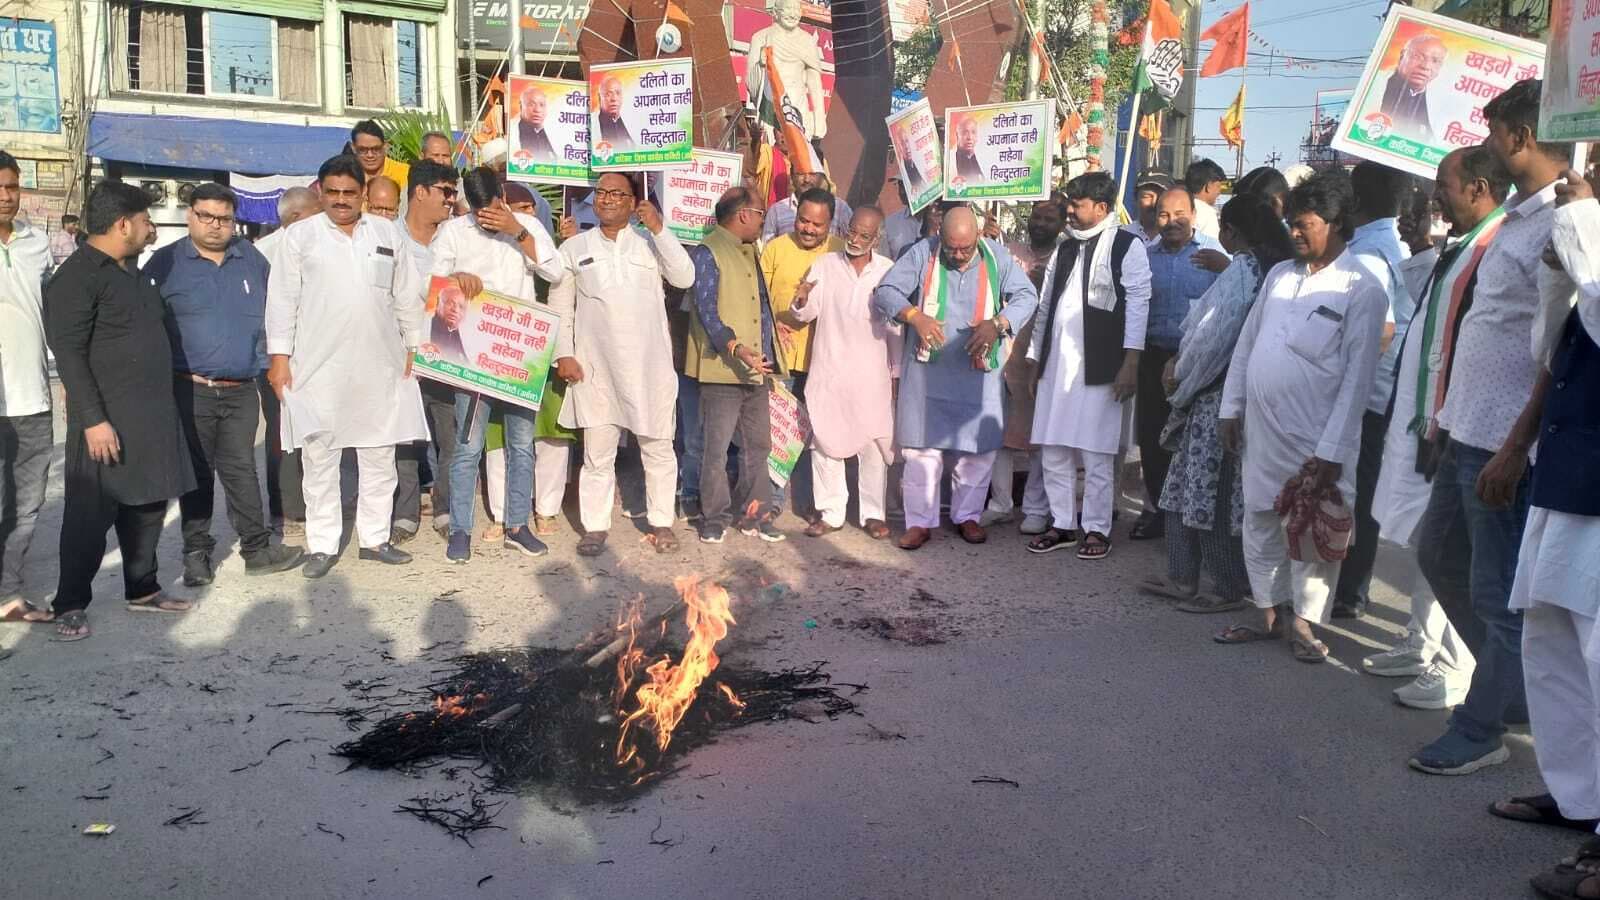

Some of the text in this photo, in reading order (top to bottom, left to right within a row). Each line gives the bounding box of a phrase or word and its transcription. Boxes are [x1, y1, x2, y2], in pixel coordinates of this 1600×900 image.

[671, 73, 685, 86] का
[633, 93, 671, 108] अपमान
[558, 112, 591, 125] अपमा
[649, 109, 677, 125] सहेगा
[1020, 114, 1033, 126] का
[574, 128, 591, 143] सहे
[640, 128, 687, 148] हिन्दुस्तान
[986, 132, 1019, 146] अपमान
[999, 147, 1024, 162] सहेगा
[717, 166, 732, 178] का
[990, 164, 1031, 183] हिन्दुस्तान
[670, 176, 708, 192] अपमान
[682, 193, 712, 209] सहेगा
[516, 312, 532, 328] जी
[534, 318, 551, 334] का
[477, 320, 522, 343] अपमान
[491, 342, 525, 361] सहेगा
[476, 352, 529, 381] हिन्दुस्तान
